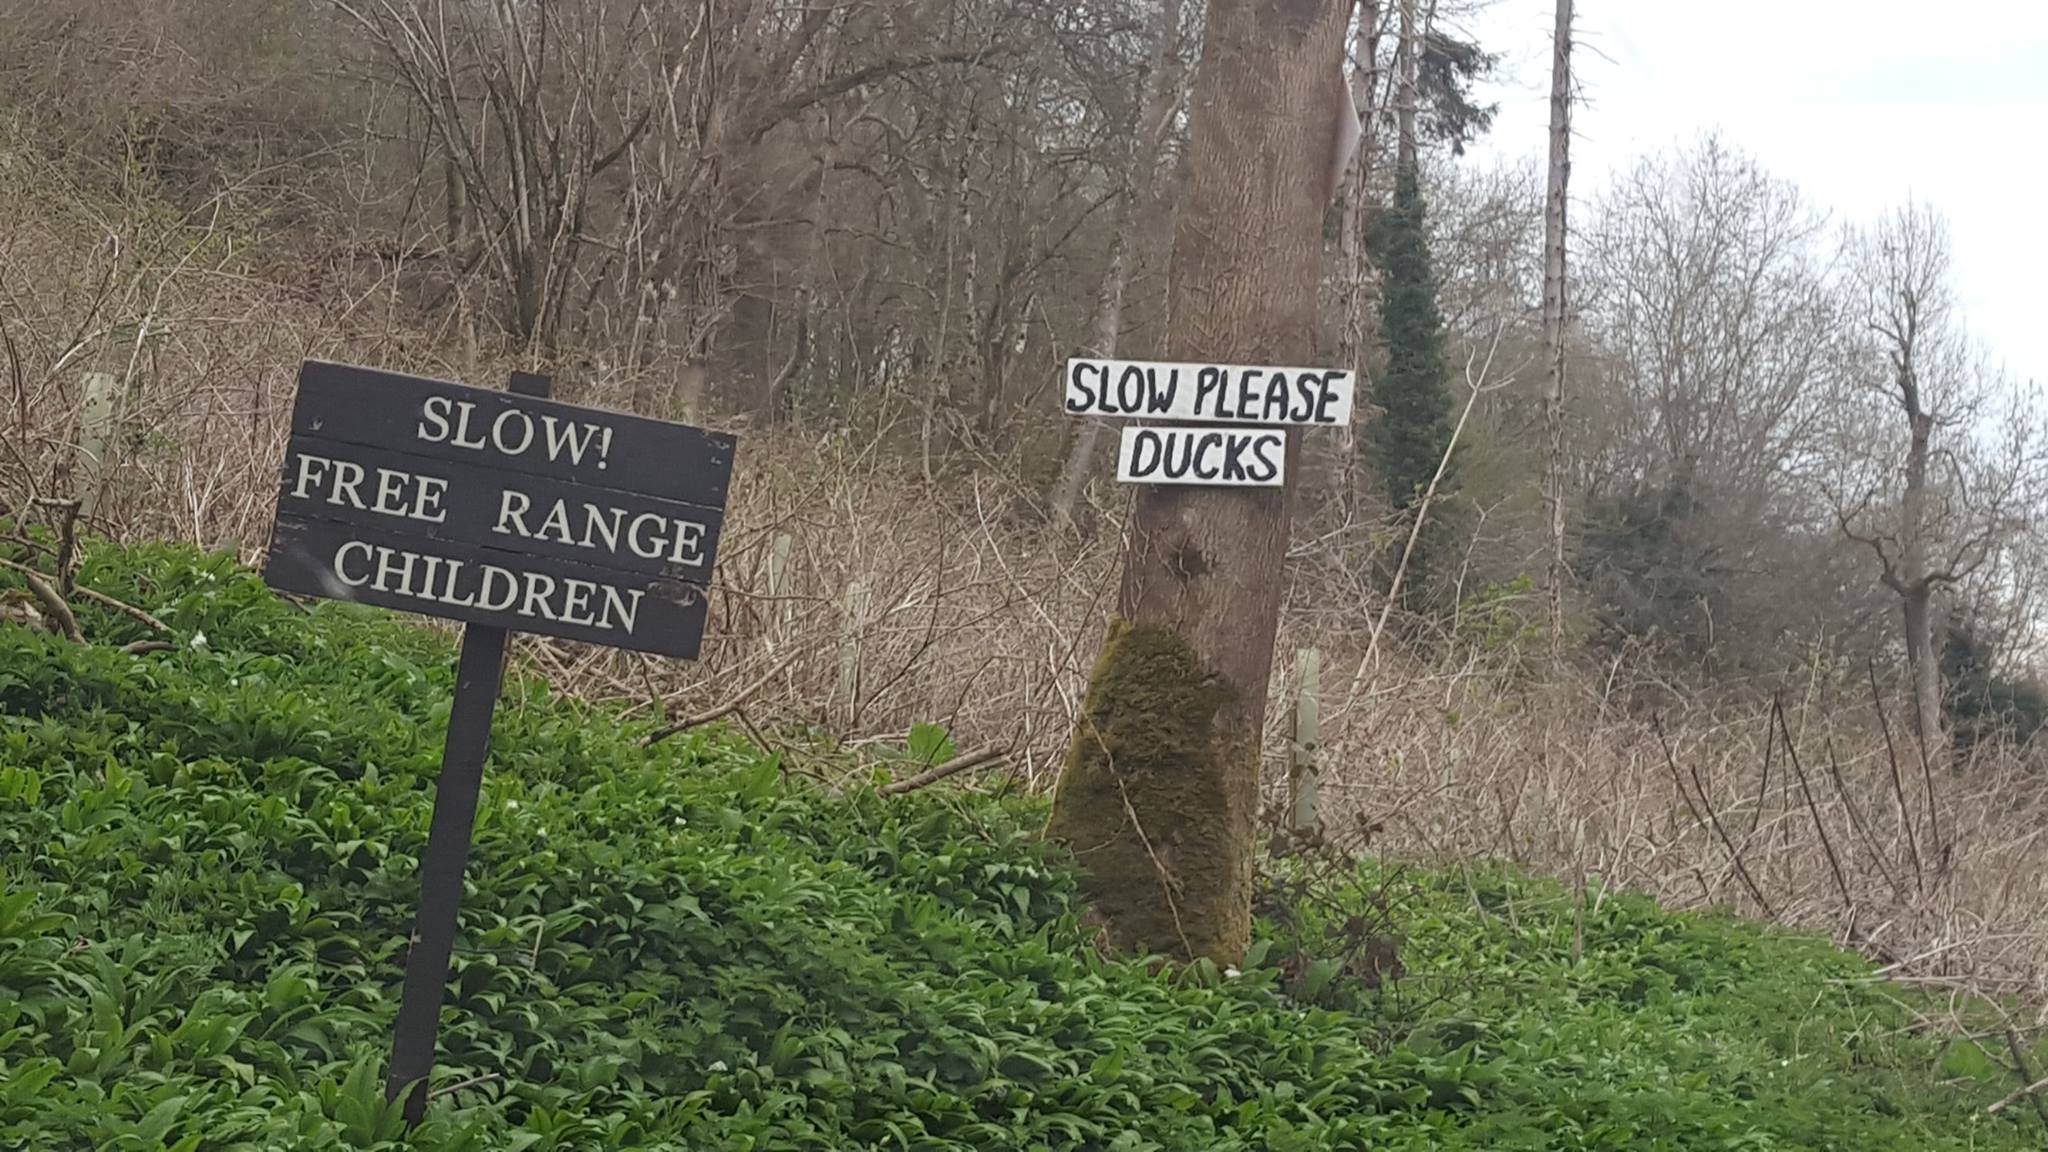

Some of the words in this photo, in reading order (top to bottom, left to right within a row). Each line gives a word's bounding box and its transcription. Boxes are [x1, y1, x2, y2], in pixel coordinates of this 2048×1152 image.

[1066, 362, 1178, 414] SLOW
[1193, 367, 1347, 423] PLEASE
[418, 396, 613, 470] SLOW!
[1129, 430, 1282, 482] DUCKS
[290, 453, 448, 523] FREE
[492, 490, 706, 567] RANGE
[334, 541, 645, 634] CHILDREN
